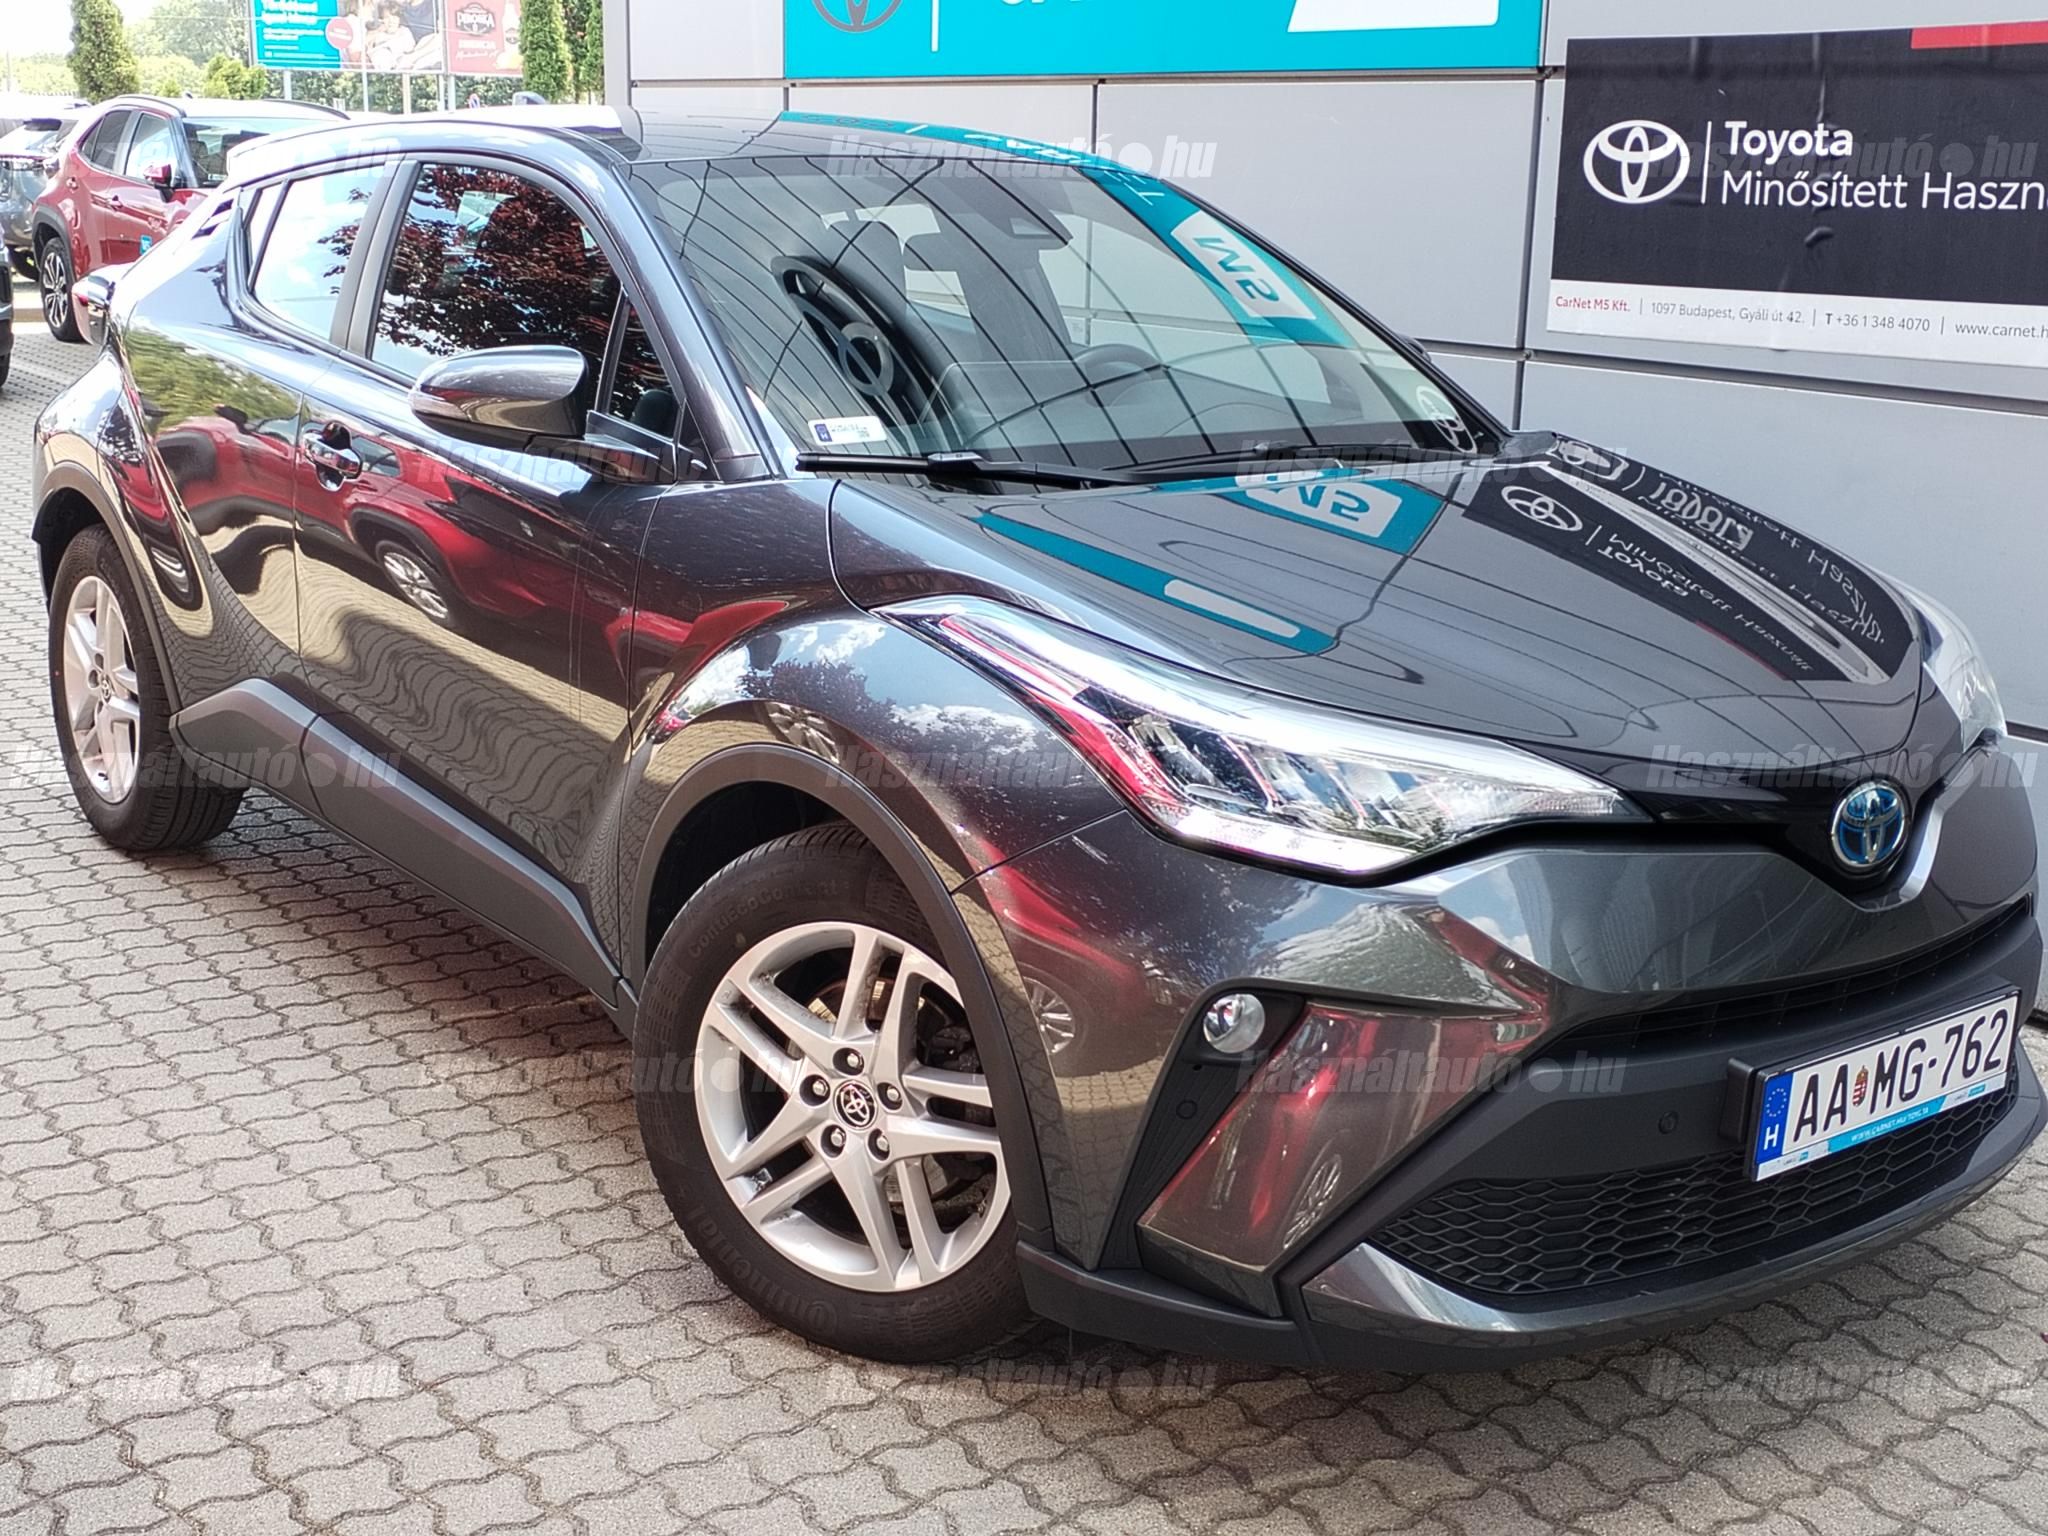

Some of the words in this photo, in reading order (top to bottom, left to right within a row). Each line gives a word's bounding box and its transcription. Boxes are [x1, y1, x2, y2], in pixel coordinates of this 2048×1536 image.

[1724, 121, 1853, 165] Toyota
[1722, 169, 1908, 208] Minősített
[1921, 171, 2048, 210] Haszn
[1556, 296, 1591, 309] CarNet
[1594, 298, 1610, 310] M5
[1612, 299, 1631, 312] Kft.
[1652, 302, 1676, 315] 1097
[1679, 303, 1735, 320] Budapest,
[1739, 306, 1769, 322] Gyáli
[1825, 313, 1833, 325] T
[1836, 314, 1858, 326] +36
[1863, 315, 1868, 327] 1
[1872, 316, 1894, 329] 348
[1898, 317, 1931, 331] 4070
[1793, 1064, 1848, 1142] AA
[1869, 1008, 2007, 1115] MG-762
[1763, 1124, 1779, 1150] H
